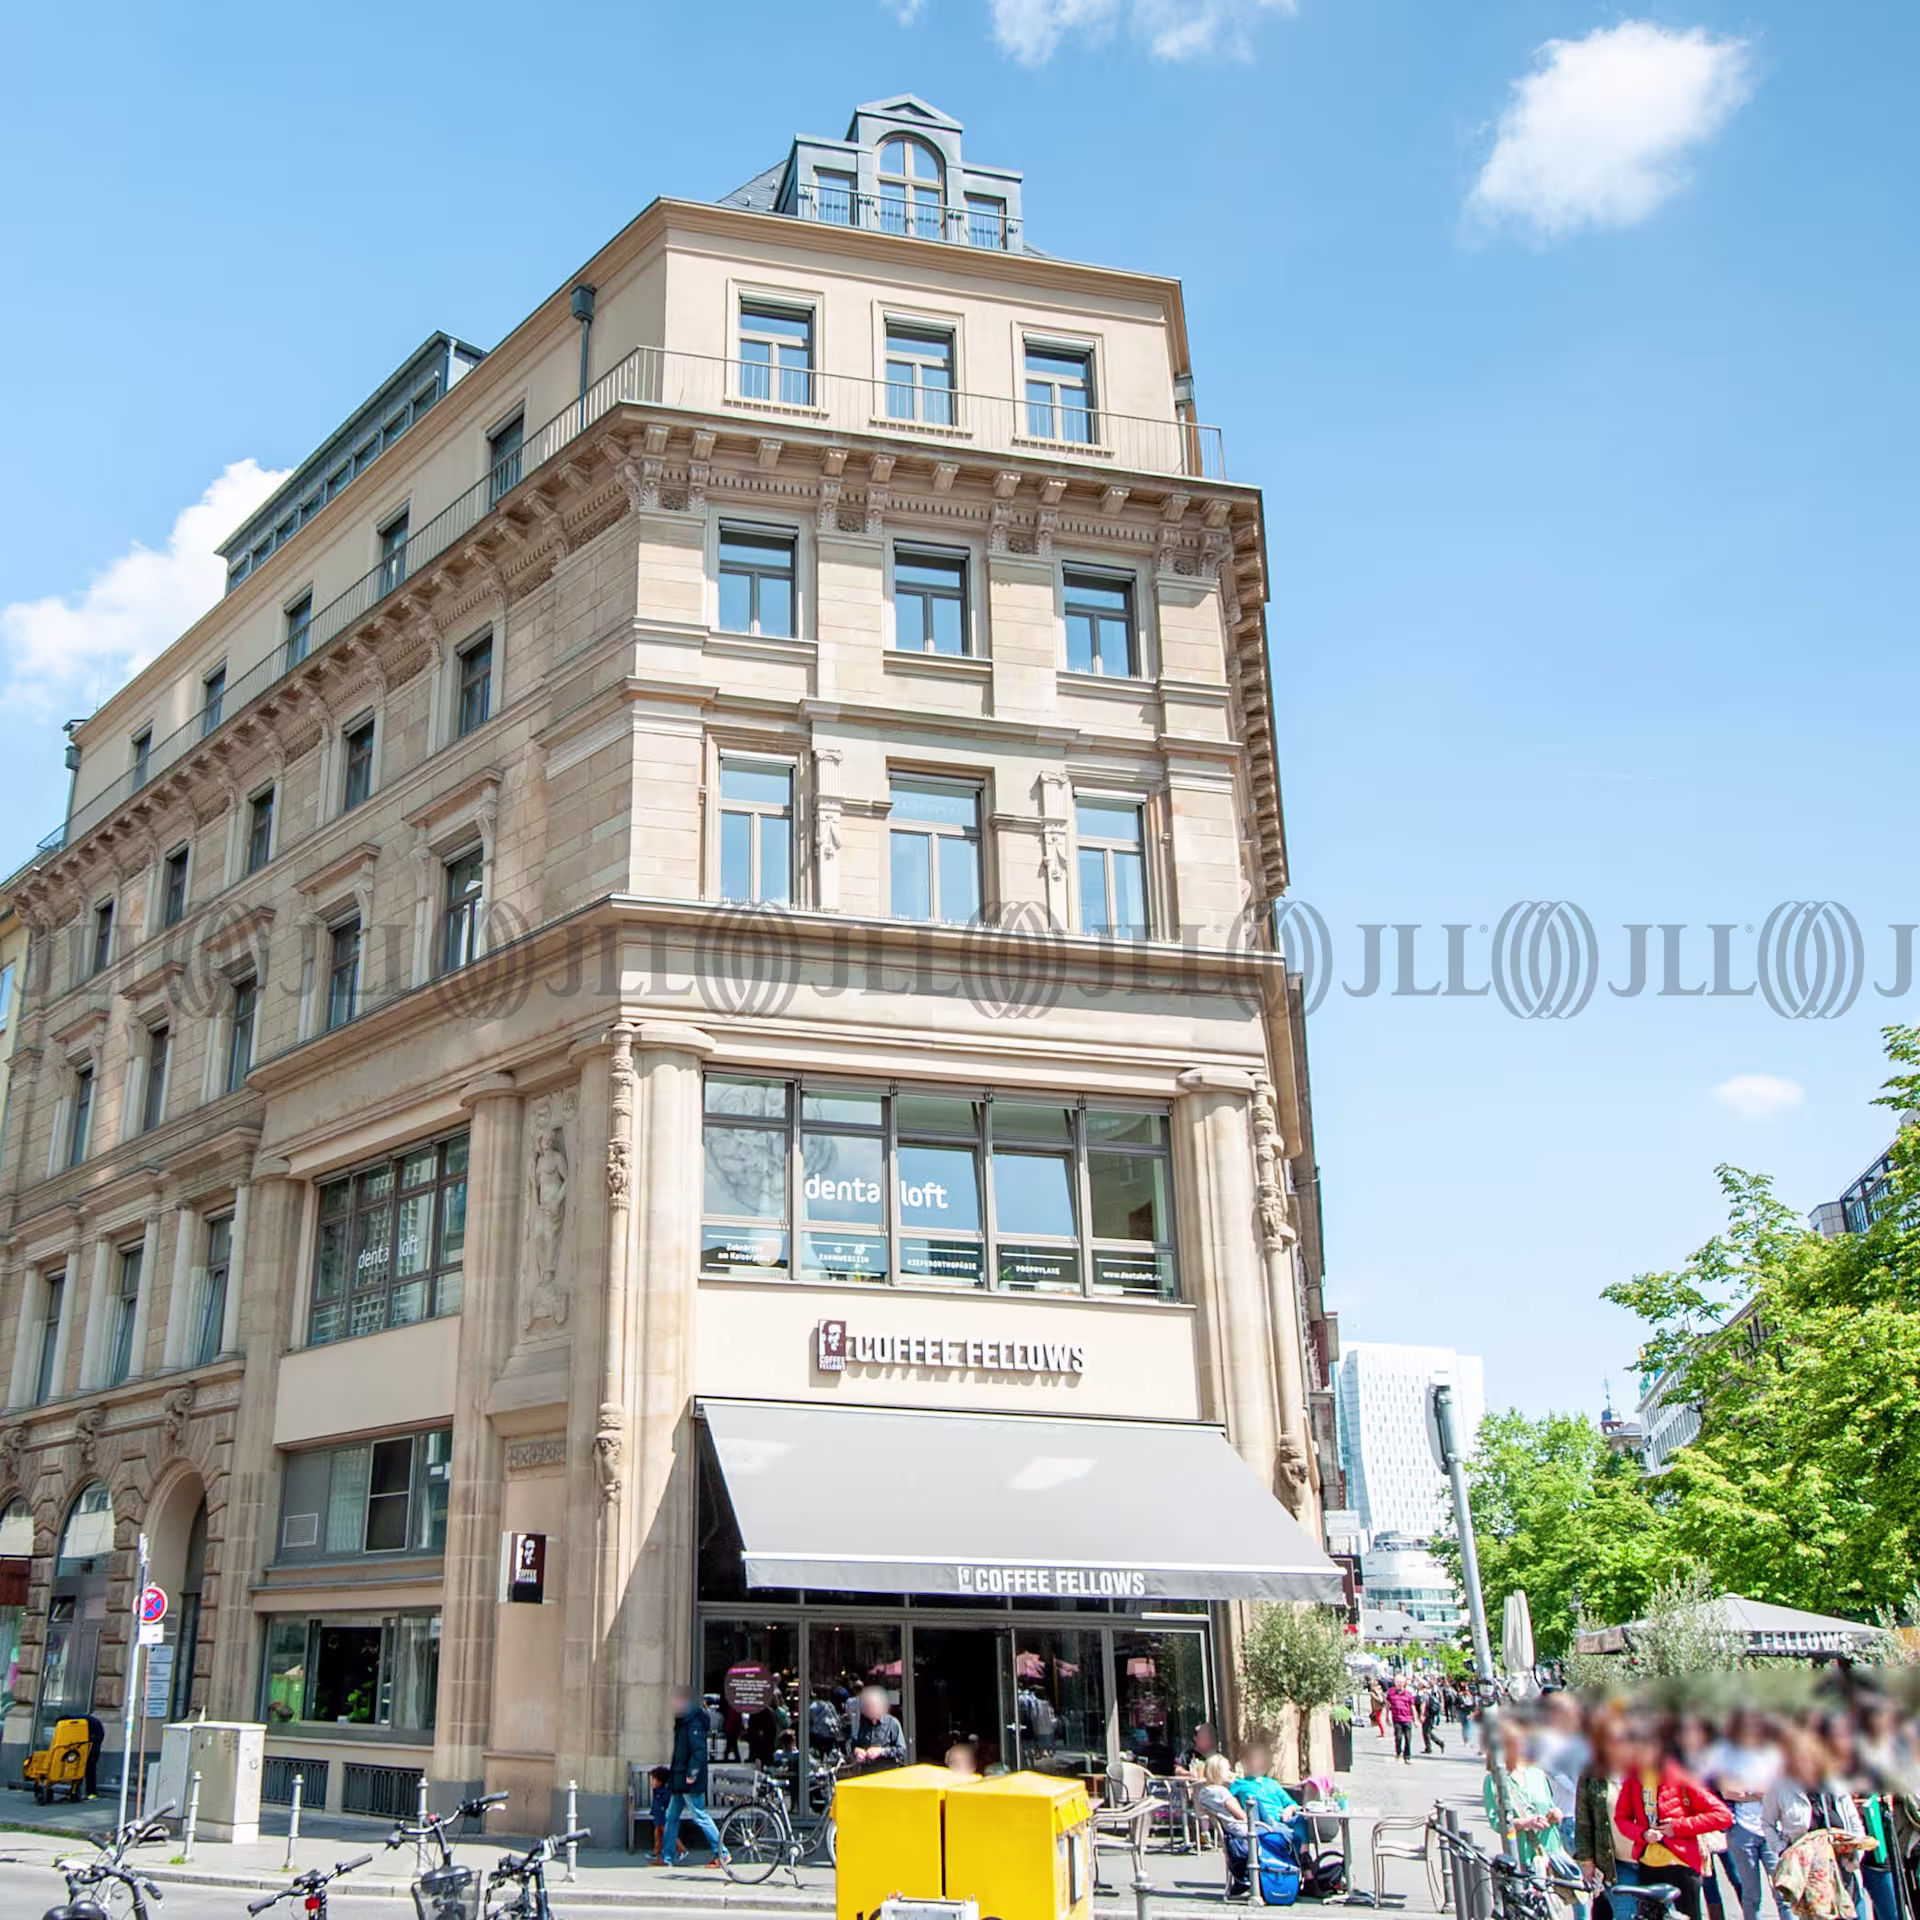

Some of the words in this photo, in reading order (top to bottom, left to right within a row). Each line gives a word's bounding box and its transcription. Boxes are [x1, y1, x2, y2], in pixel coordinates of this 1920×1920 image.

[852, 1335, 960, 1367] COFFEE
[966, 1338, 1084, 1373] FELLOWS
[975, 1568, 1050, 1593] COFFEE
[1055, 1570, 1145, 1595] FELLOWS
[1760, 1631, 1854, 1657] FELLOWS
